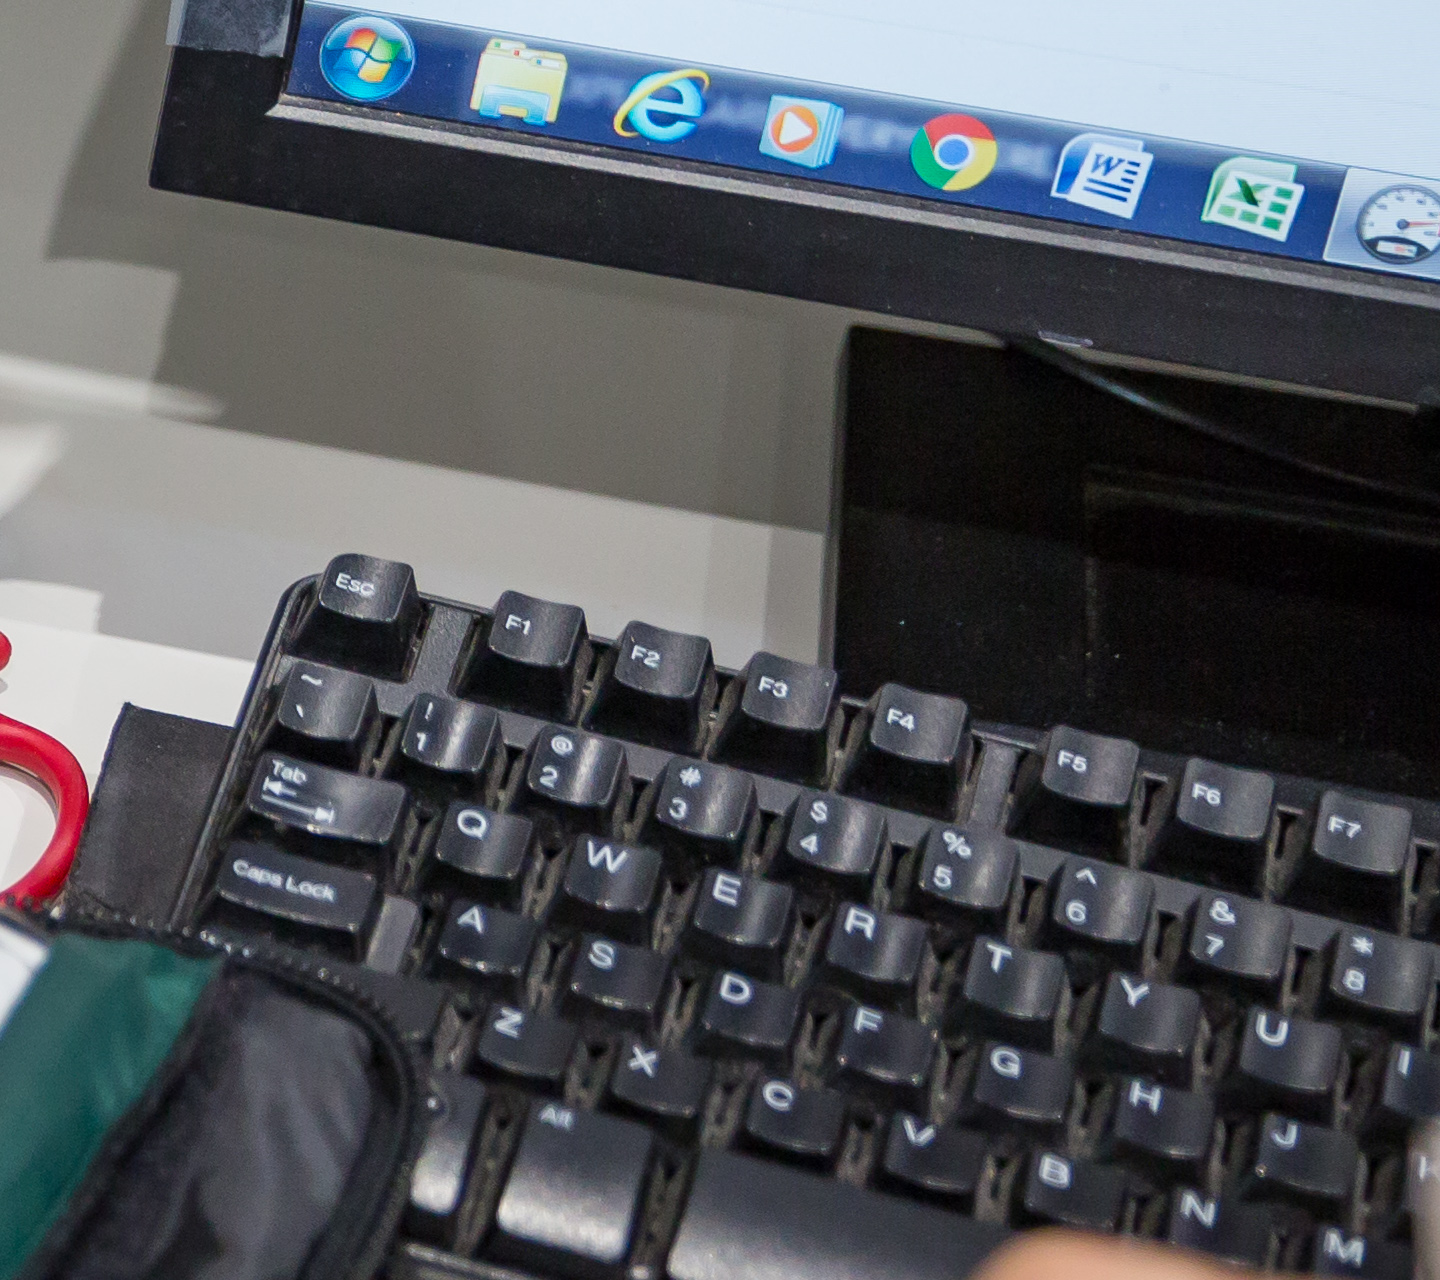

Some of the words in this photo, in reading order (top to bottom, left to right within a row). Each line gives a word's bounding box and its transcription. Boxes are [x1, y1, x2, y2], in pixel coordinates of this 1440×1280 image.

[335, 572, 375, 597] Esc
[505, 613, 530, 636] F1
[630, 644, 660, 667] F2
[270, 759, 307, 783] Tab
[233, 858, 281, 889] Caps
[284, 873, 336, 903] Lock
